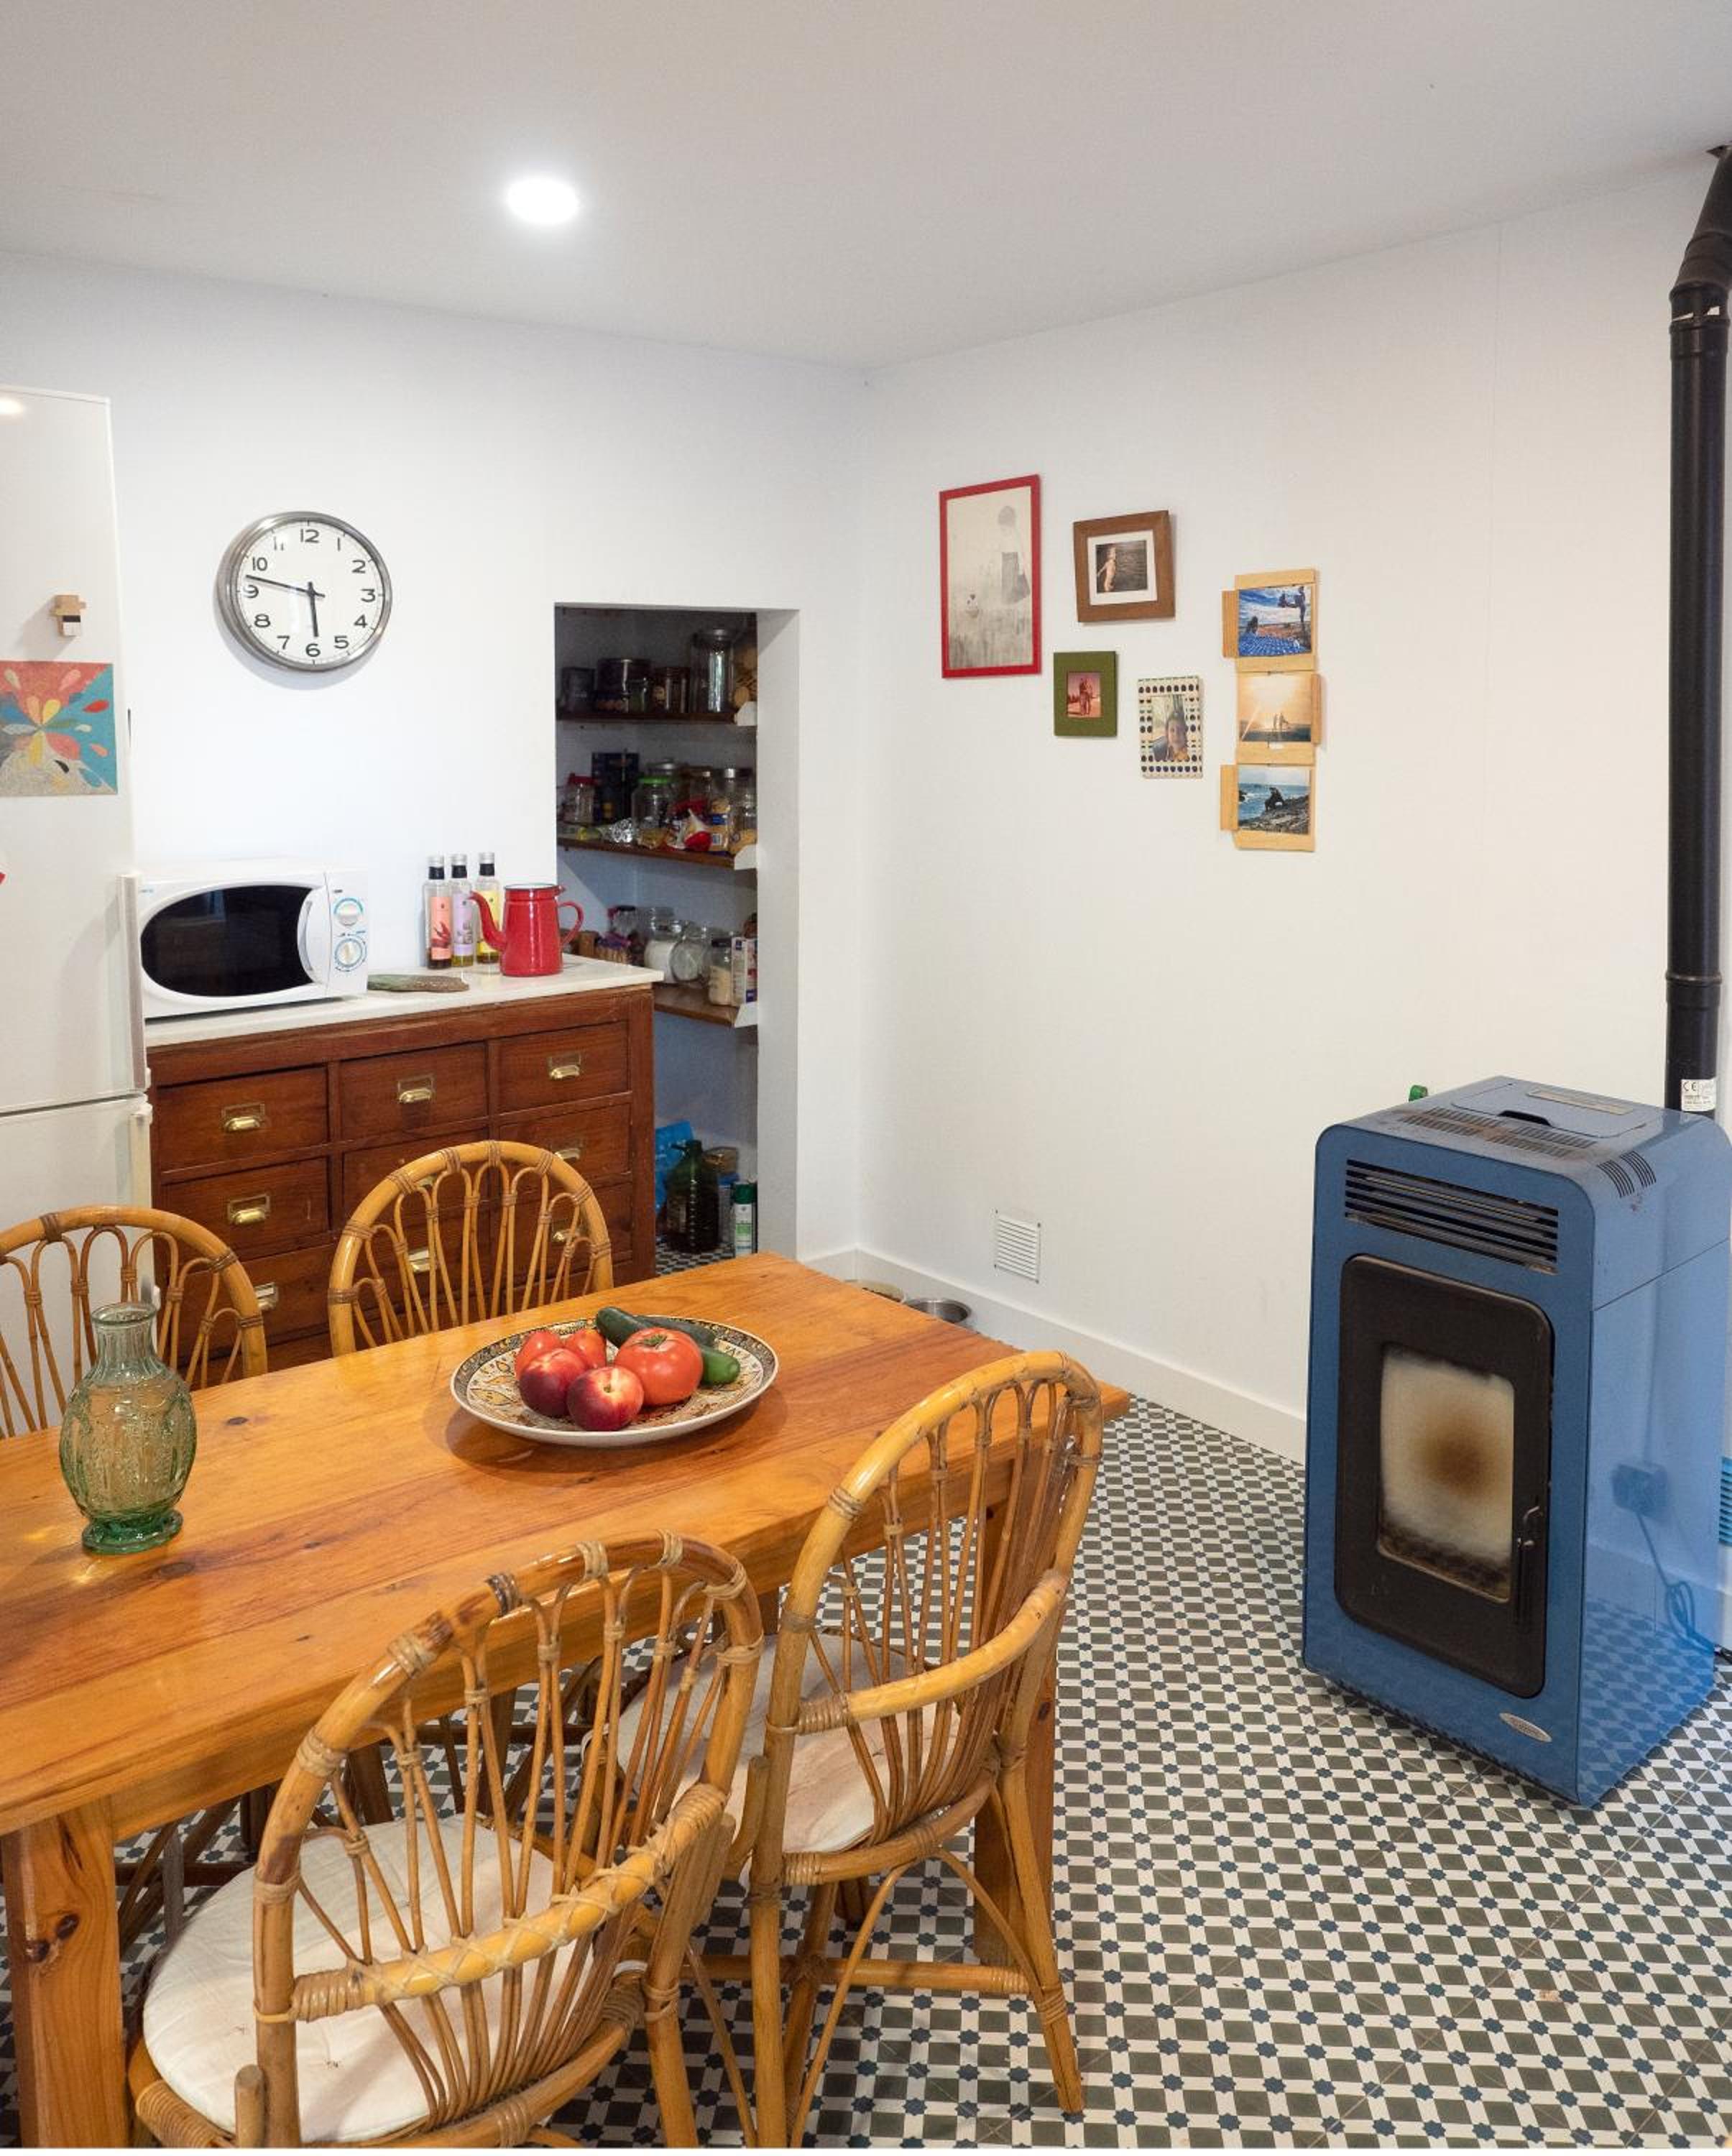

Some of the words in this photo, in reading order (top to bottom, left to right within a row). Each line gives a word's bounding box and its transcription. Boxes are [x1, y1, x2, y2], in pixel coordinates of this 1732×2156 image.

[300, 529, 320, 543] 12
[336, 538, 341, 551] 1
[252, 557, 268, 571] 10
[352, 560, 366, 573] 2
[243, 584, 259, 599] 9
[361, 589, 376, 603] 3
[254, 614, 270, 627] 8
[354, 614, 367, 628] 4
[277, 635, 290, 650] 7
[334, 635, 349, 649] 5
[305, 643, 321, 657] 6
[1683, 1082, 1697, 1092] CE
